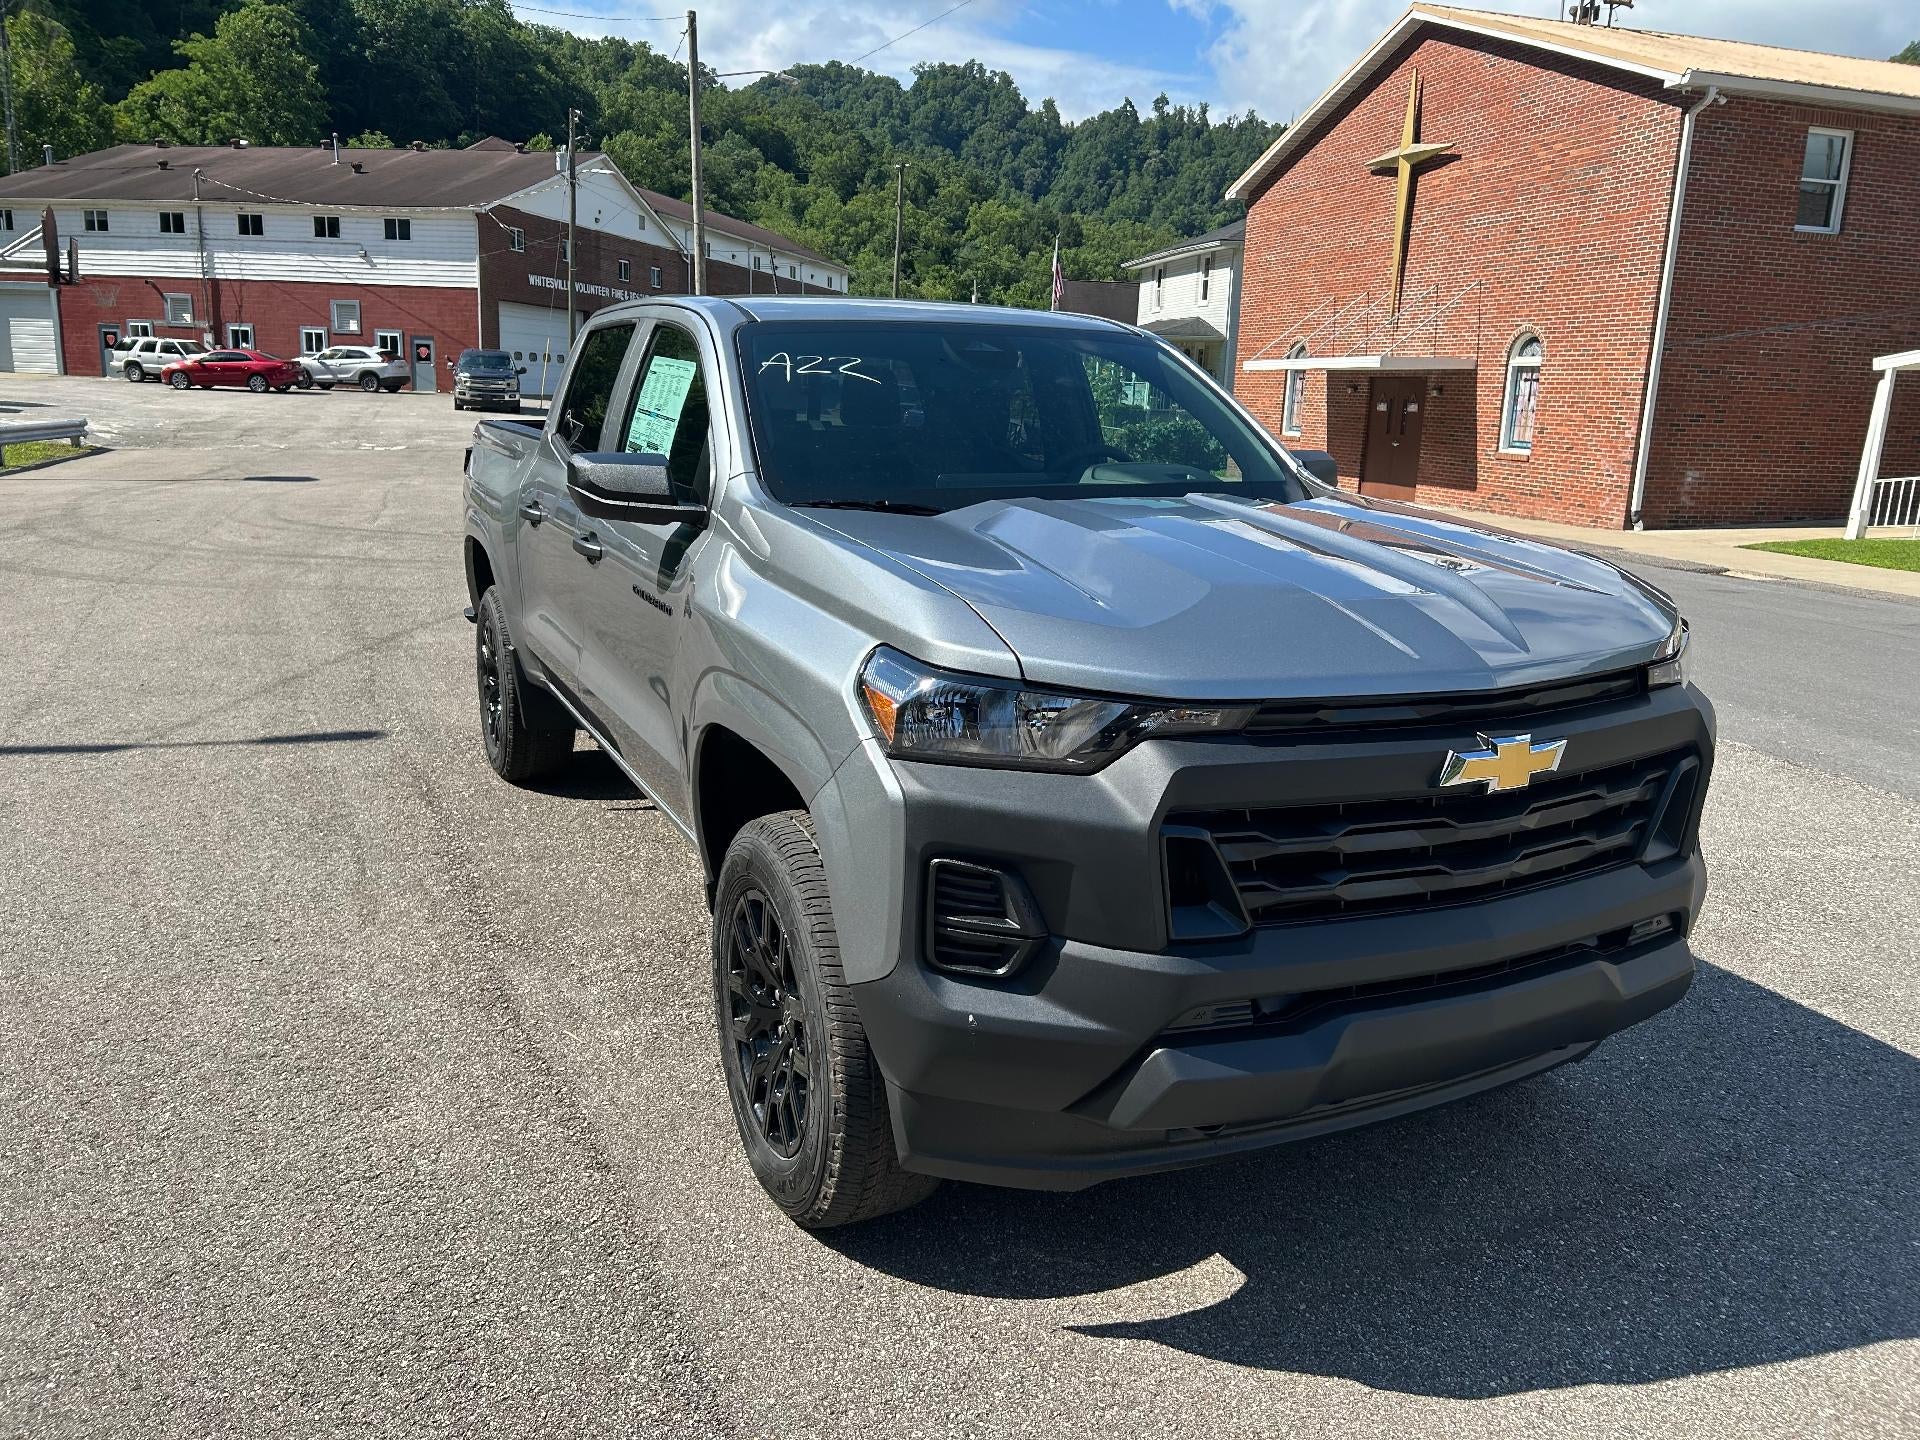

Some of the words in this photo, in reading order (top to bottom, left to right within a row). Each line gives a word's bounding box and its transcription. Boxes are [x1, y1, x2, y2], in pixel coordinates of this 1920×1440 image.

[528, 273, 570, 291] WHITESVILL
[574, 281, 610, 298] VOLUNTEER
[611, 287, 625, 301] FIRE
[624, 290, 630, 301] &
[758, 352, 882, 384] A22
